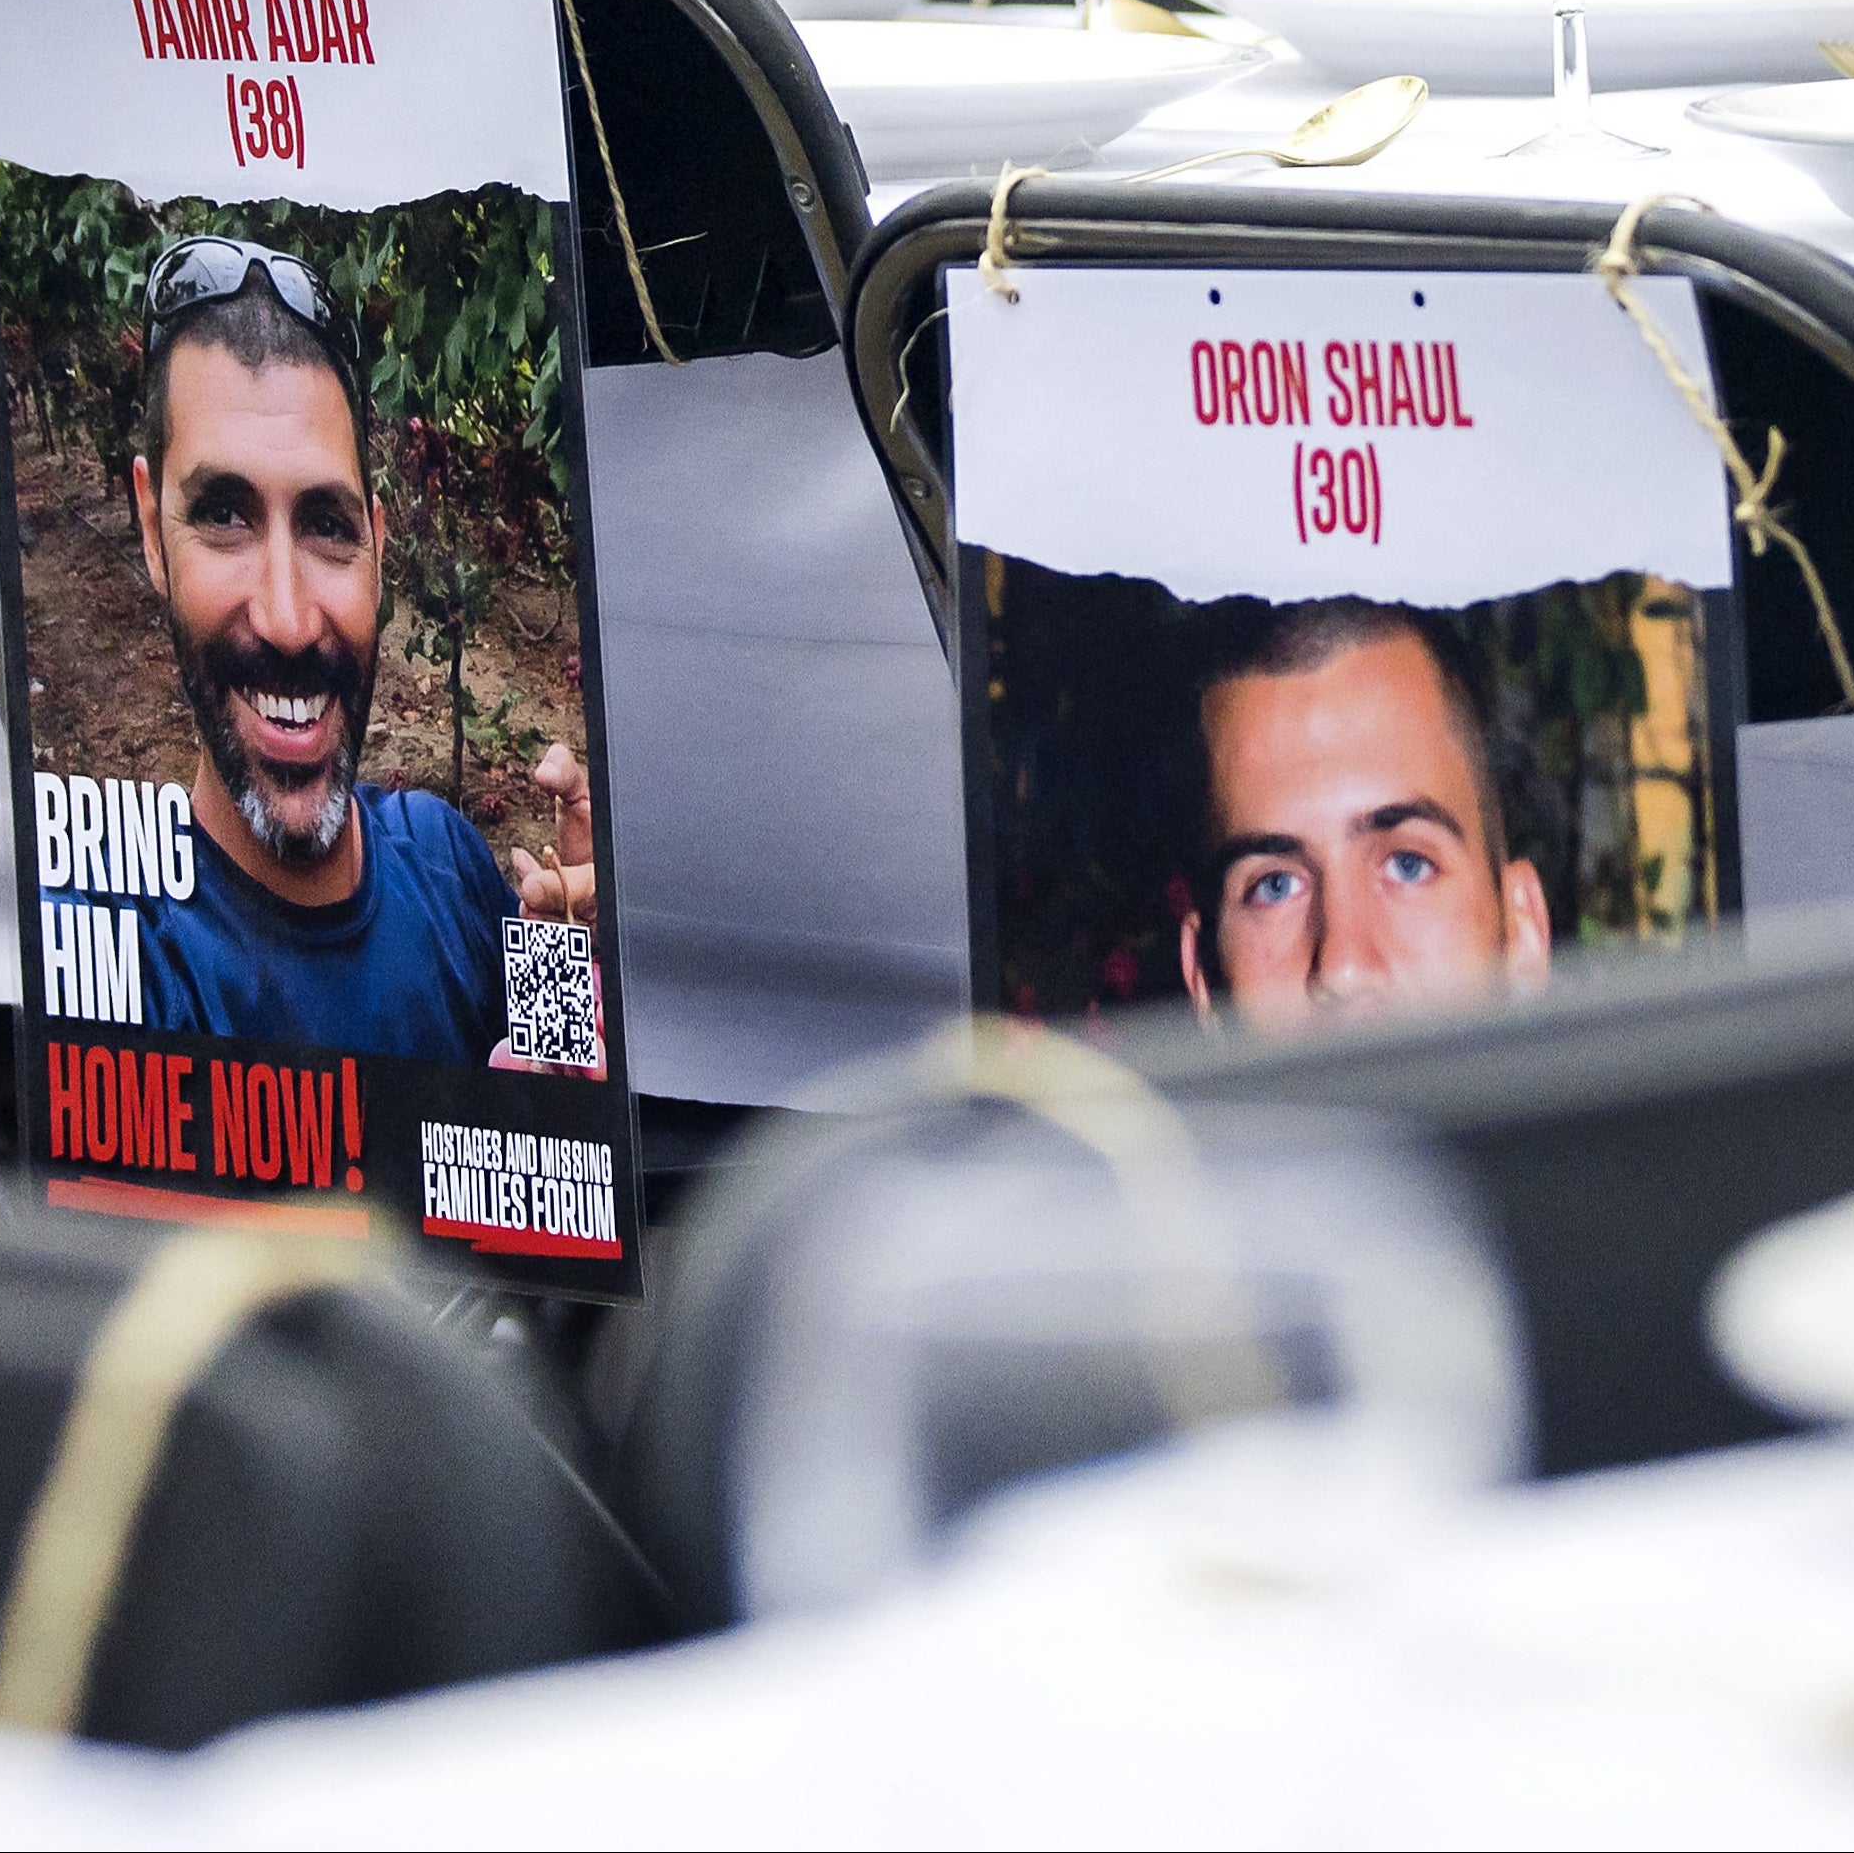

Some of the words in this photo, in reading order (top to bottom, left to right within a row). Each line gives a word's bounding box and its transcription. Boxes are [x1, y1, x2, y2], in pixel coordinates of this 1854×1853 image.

[226, 73, 304, 169] (38)
[1191, 340, 1310, 426] ORON
[1323, 340, 1474, 427] SHAUL
[1293, 441, 1381, 544] (30)
[33, 772, 196, 900] BRING
[40, 900, 143, 1025] HIM
[47, 1042, 197, 1172] HOME
[210, 1057, 365, 1193] NOW!
[421, 1120, 503, 1171] HOSTAGES
[505, 1132, 537, 1175] AND
[540, 1136, 613, 1186] MISSING
[423, 1162, 527, 1231] FAMILIES
[531, 1177, 617, 1243] FORUM
